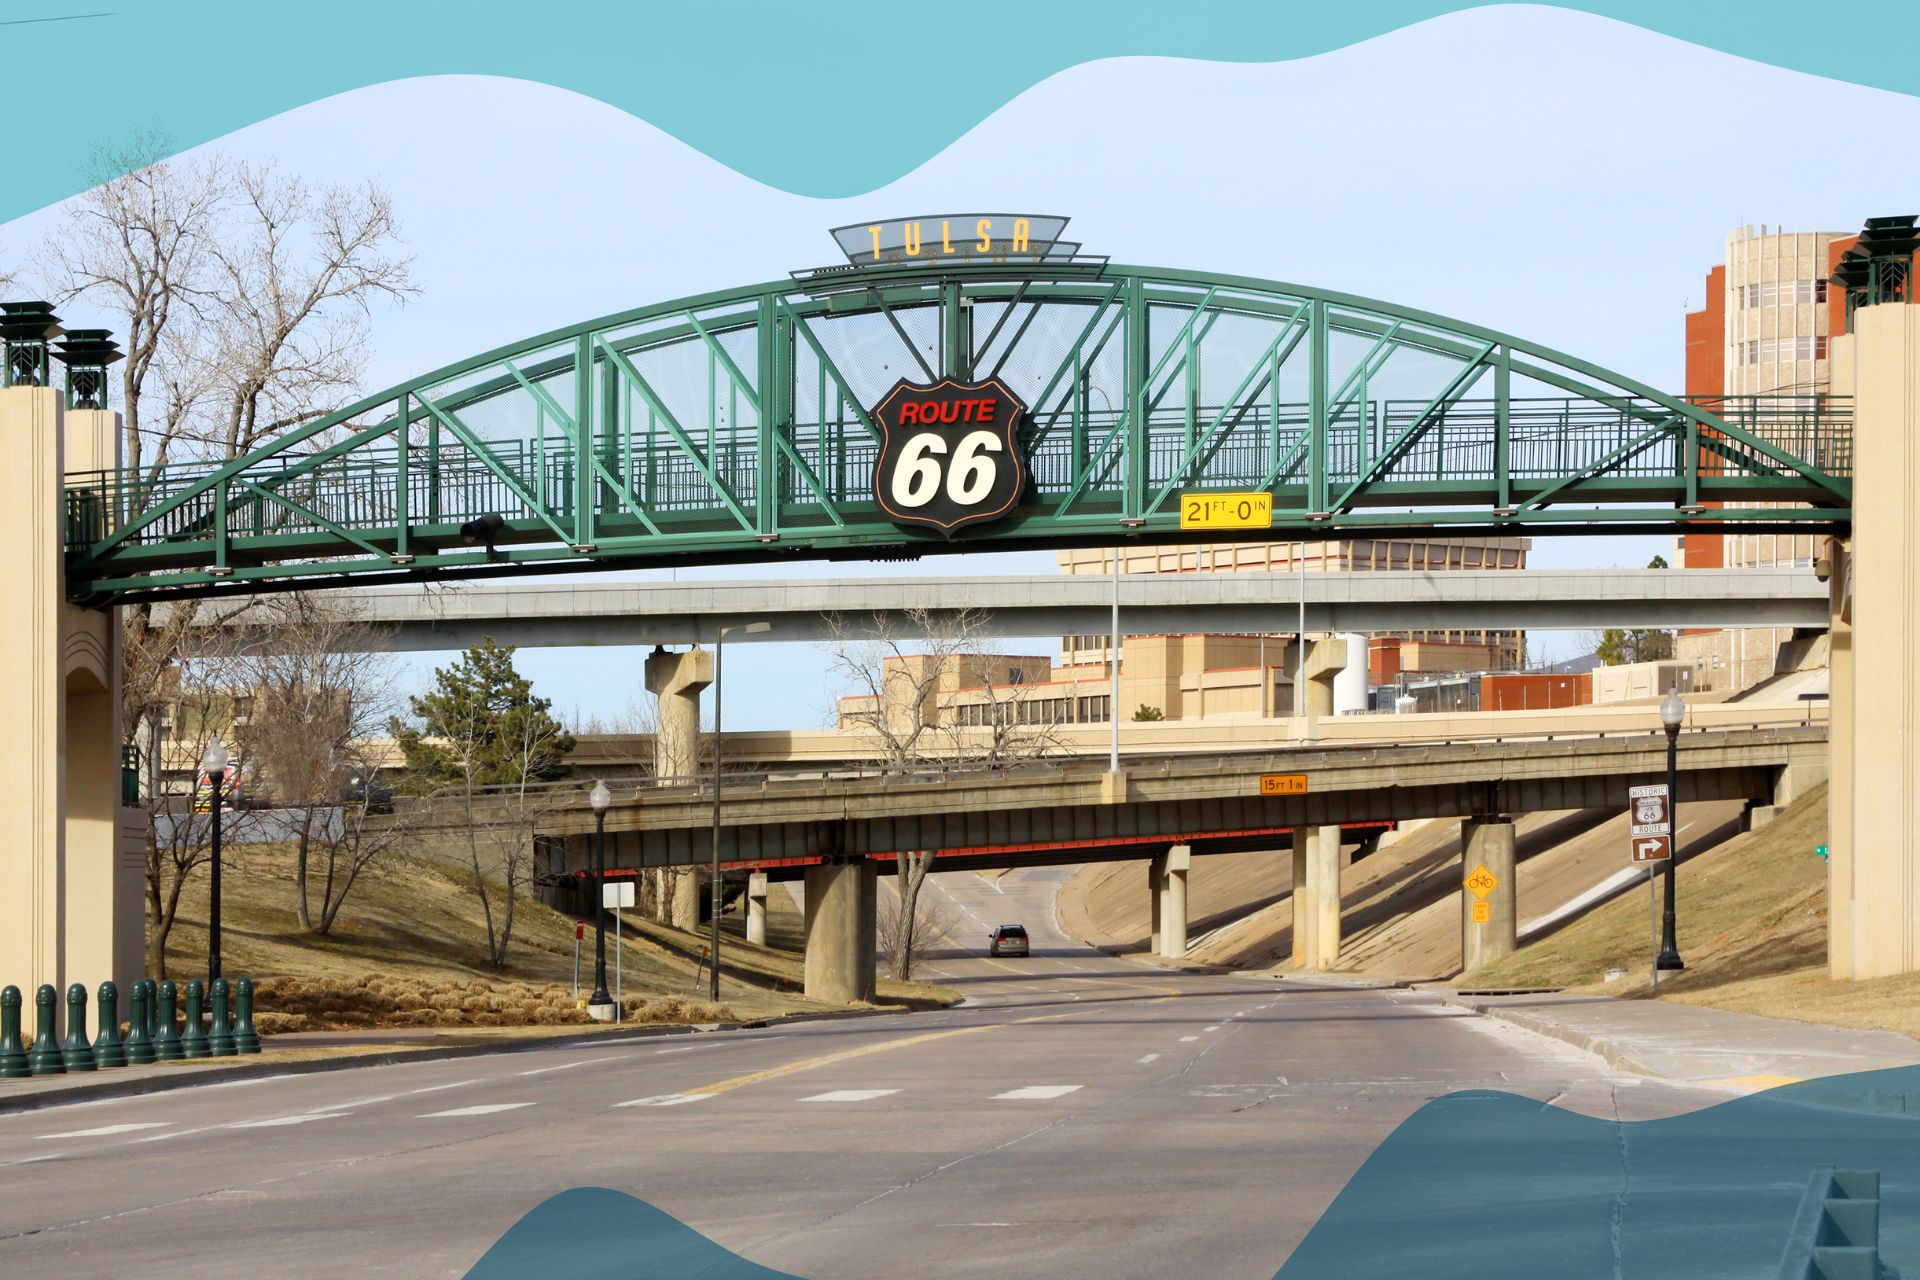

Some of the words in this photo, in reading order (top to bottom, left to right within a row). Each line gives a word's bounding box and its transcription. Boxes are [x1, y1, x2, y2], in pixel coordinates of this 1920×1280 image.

[868, 219, 1029, 260] TULSA
[898, 399, 997, 425] ROUTE
[891, 430, 1003, 507] 66
[1632, 787, 1665, 796] HISTORIC
[1643, 811, 1656, 820] 66
[1639, 824, 1662, 833] ROUTE
